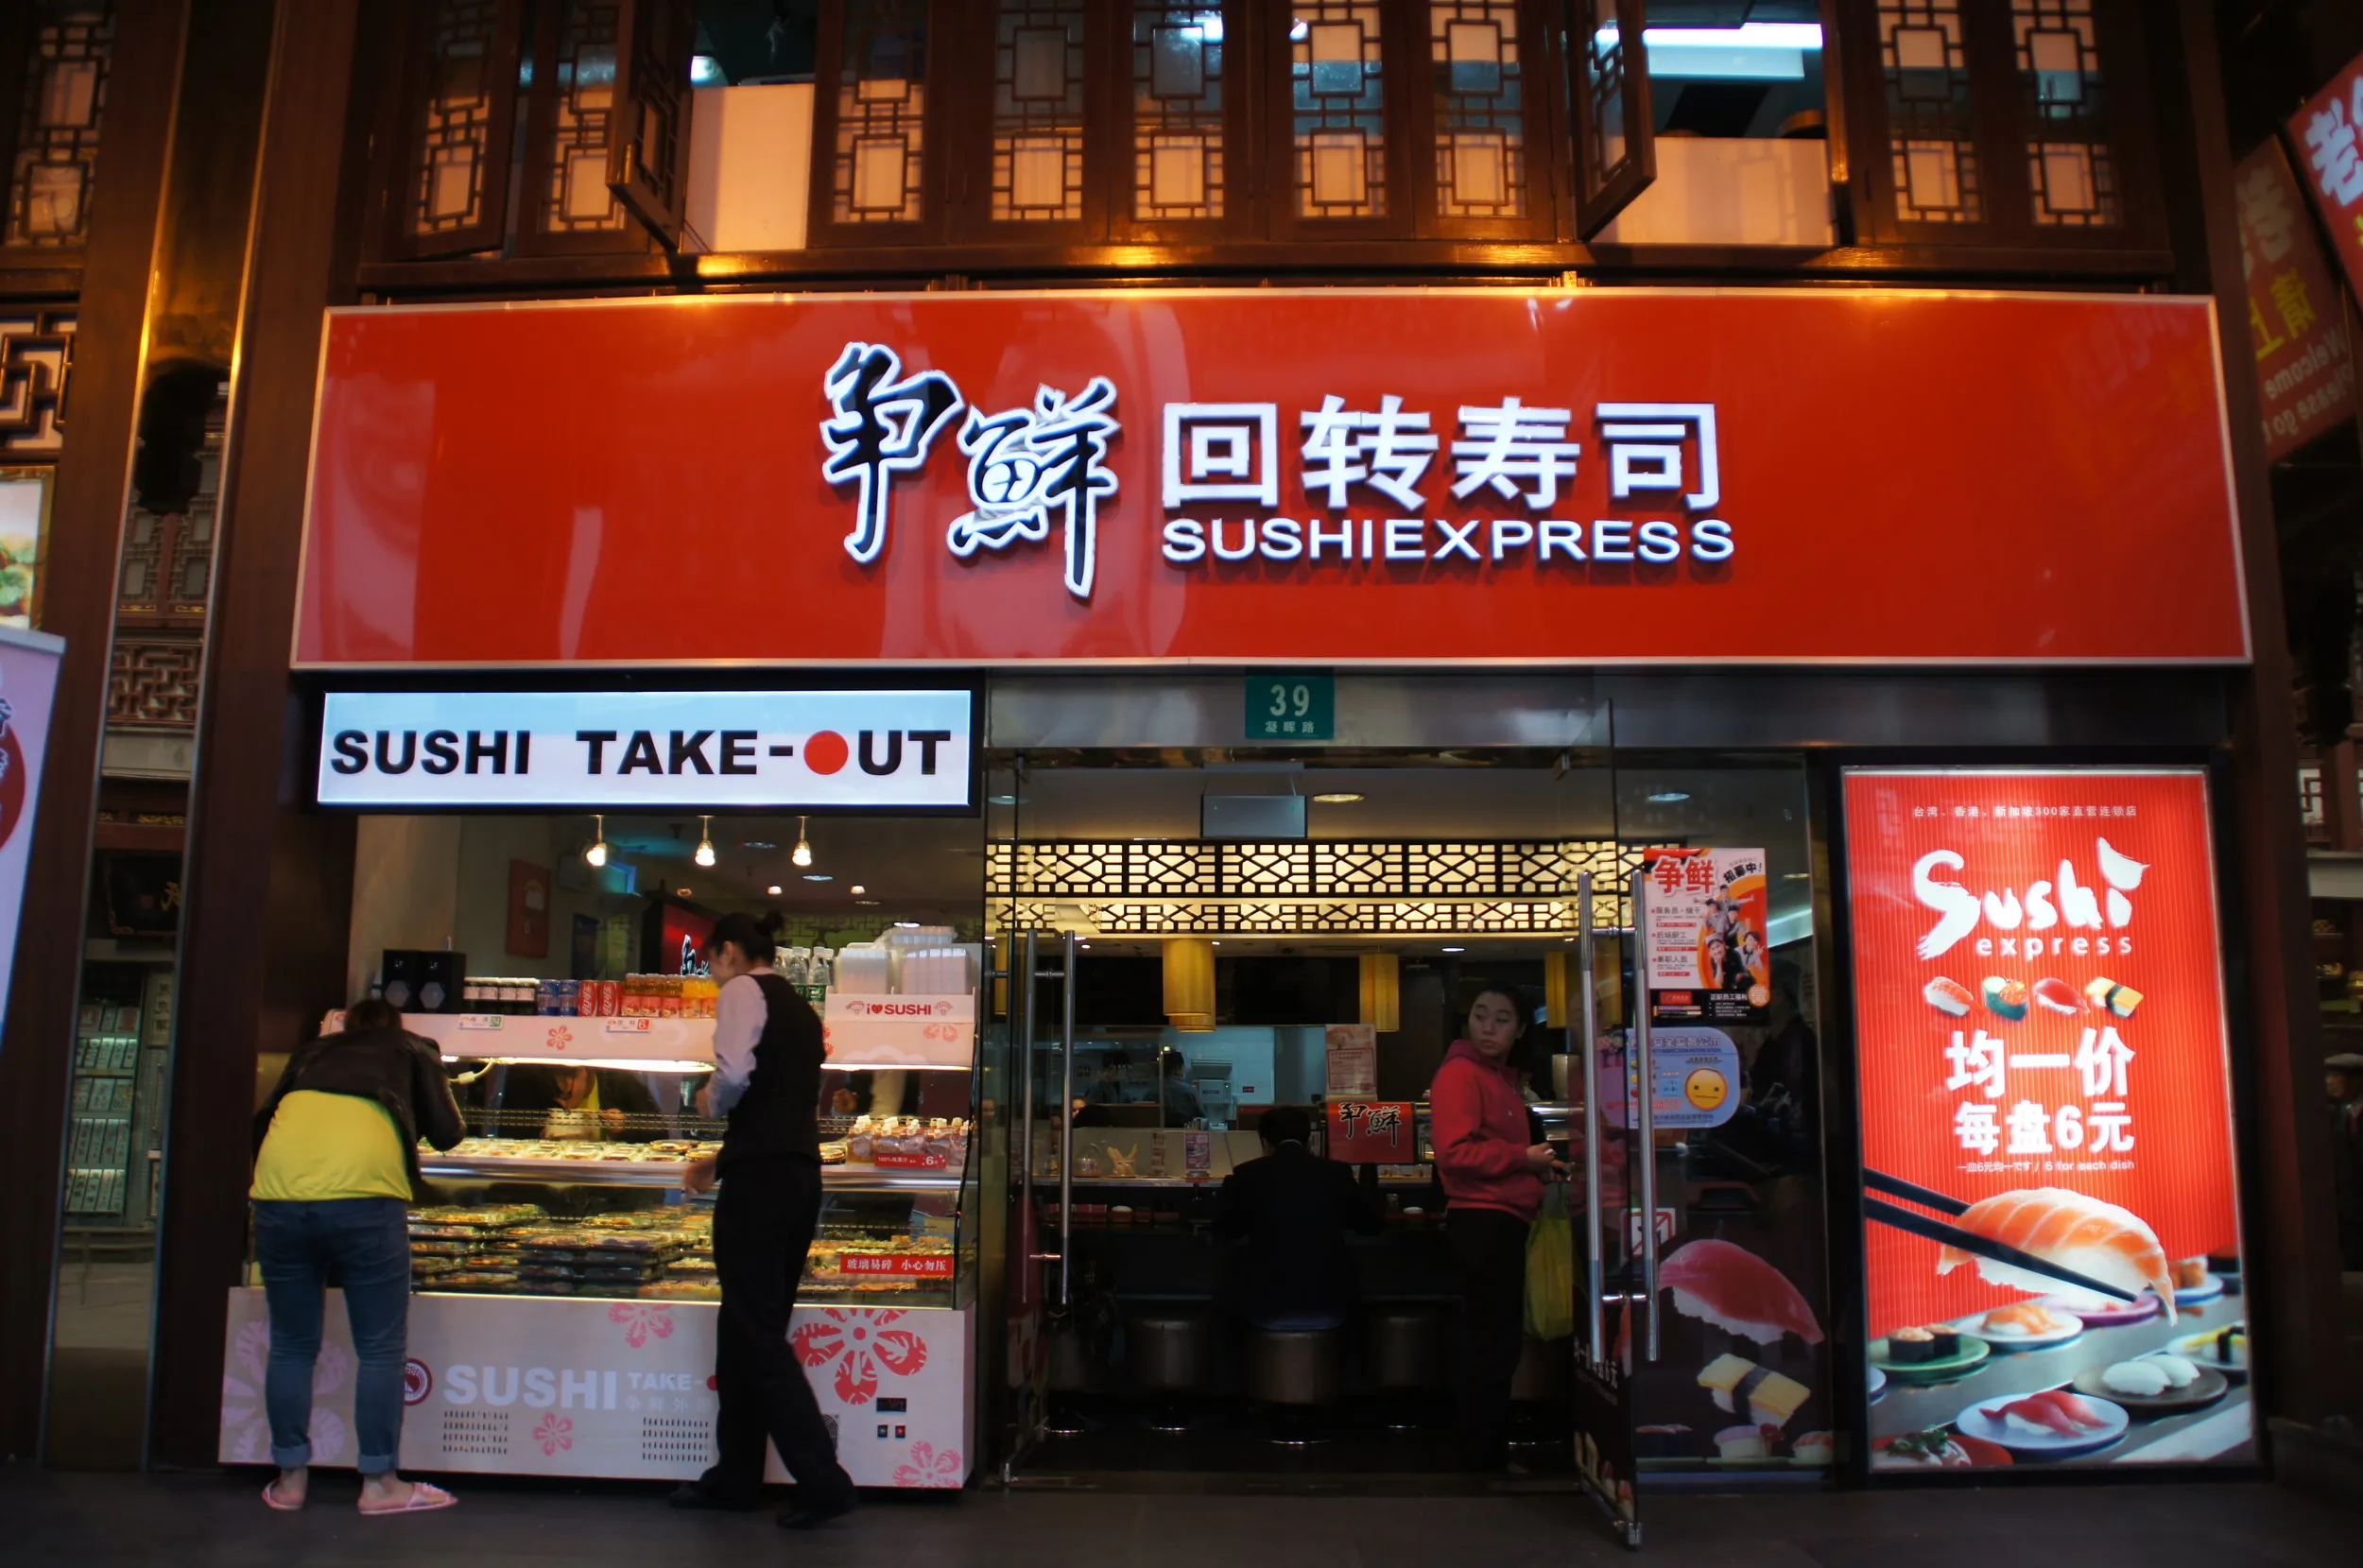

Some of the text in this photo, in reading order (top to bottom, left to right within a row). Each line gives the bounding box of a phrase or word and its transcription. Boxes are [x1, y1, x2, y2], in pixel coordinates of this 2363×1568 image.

[1163, 394, 1720, 511] 回转寿司
[1269, 684, 1310, 716] 39
[331, 730, 530, 775] SUSHI
[1653, 856, 1716, 895] 争鲜
[1913, 836, 2151, 960] Sushi
[1975, 935, 2133, 960] express
[884, 1004, 932, 1015] SUSHI
[1945, 1026, 2136, 1099] 均一价
[1955, 1100, 2136, 1156] 每盘6元
[2044, 1159, 2135, 1171] 6 for each dish
[847, 1258, 946, 1271] 玻璃易碎 小心勿压
[443, 1365, 617, 1409] SUSHI
